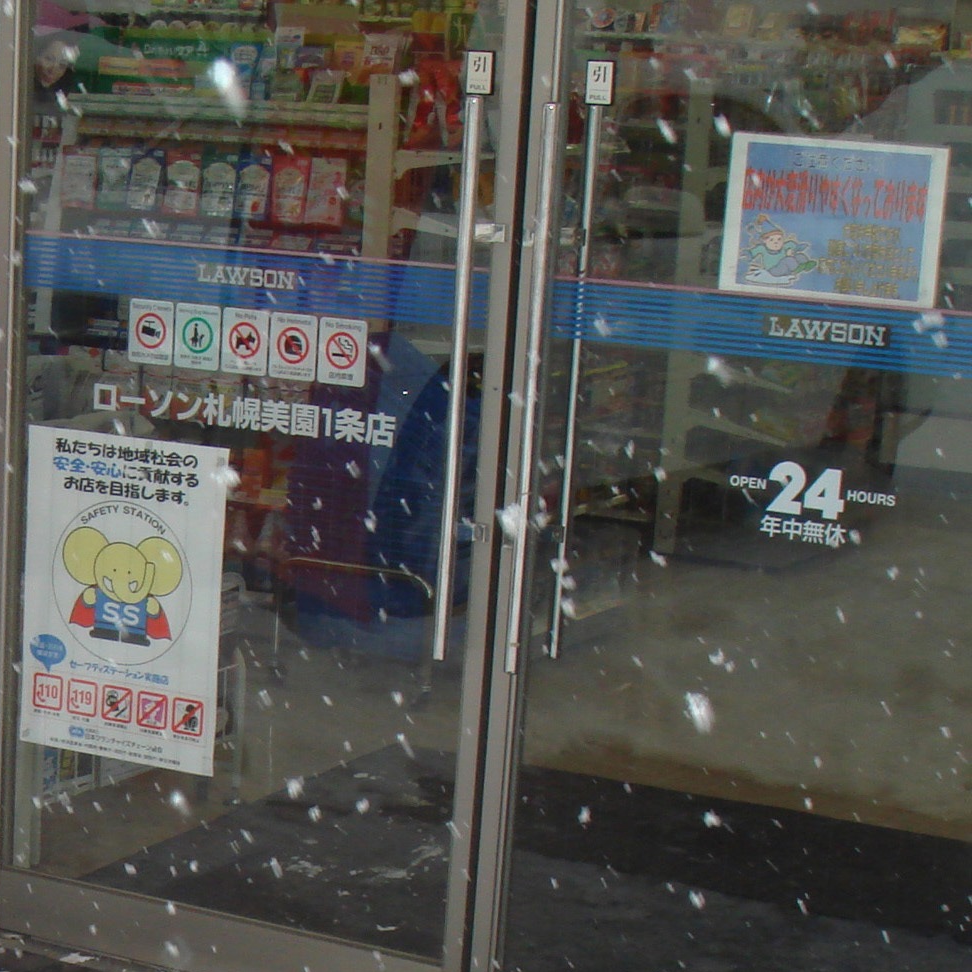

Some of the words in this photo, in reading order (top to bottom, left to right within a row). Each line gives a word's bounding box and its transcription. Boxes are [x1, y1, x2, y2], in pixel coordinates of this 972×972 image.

[473, 56, 487, 72] 引
[593, 66, 607, 83] 引
[197, 264, 297, 291] LAWSON
[768, 316, 887, 346] LAWSON
[93, 382, 397, 448] ローソン札幌美園1条店
[55, 437, 198, 469] 私たちは地域社会の
[64, 476, 190, 507] お店を目指します。
[730, 474, 766, 490] OPEN
[765, 460, 845, 521] 24
[846, 490, 896, 507] HOURS
[80, 505, 119, 525] SAFETY
[123, 506, 166, 535] STATION
[760, 514, 847, 545] 年中無休
[102, 602, 141, 627] SS
[38, 683, 58, 700] 110
[72, 689, 92, 706] 119
